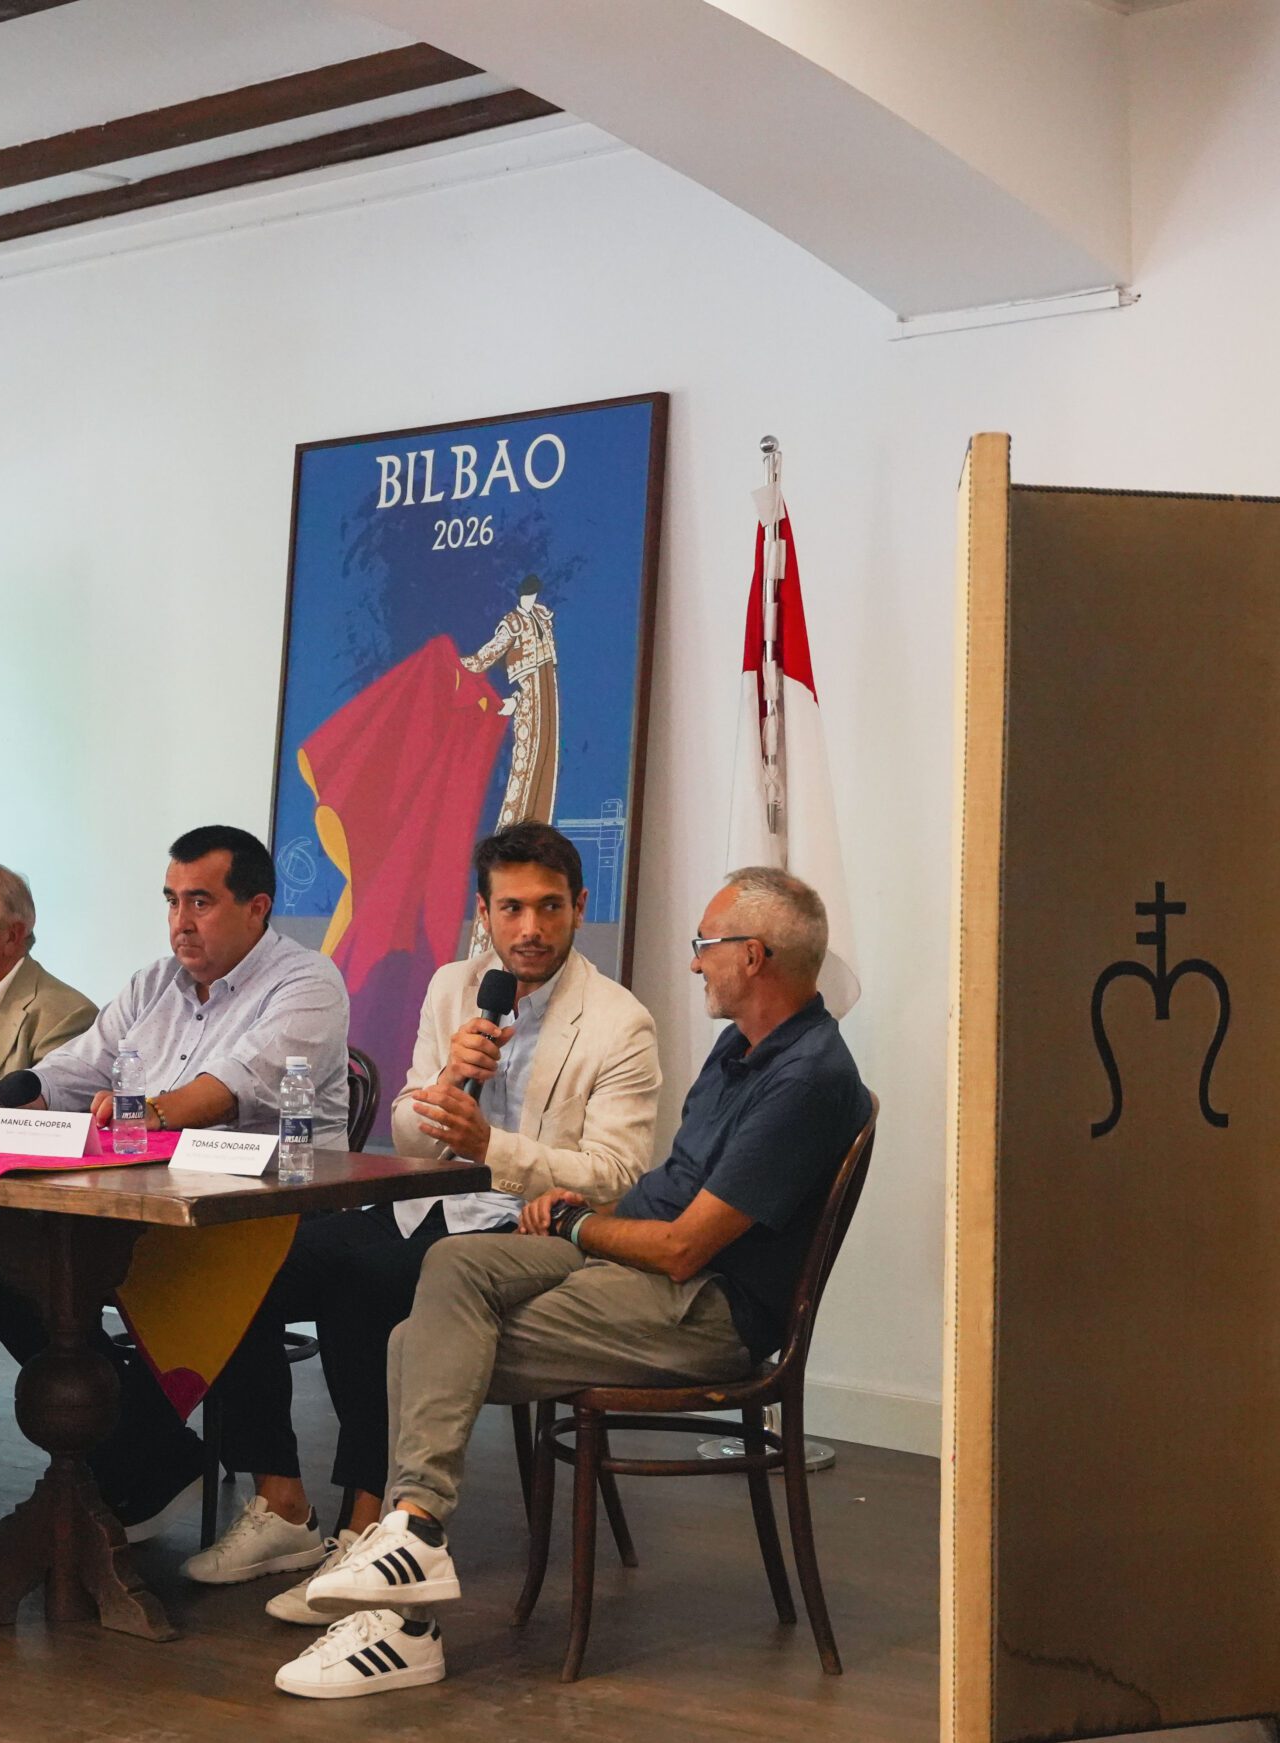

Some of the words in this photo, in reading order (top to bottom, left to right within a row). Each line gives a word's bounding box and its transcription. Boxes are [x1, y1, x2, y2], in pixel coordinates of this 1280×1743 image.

[376, 433, 567, 509] BILBAO
[431, 515, 494, 551] 2026
[122, 1110, 144, 1119] INSALUS
[284, 1135, 309, 1143] INSALUS
[192, 1140, 218, 1148] TOMAS
[221, 1142, 260, 1150] ONDARRA
